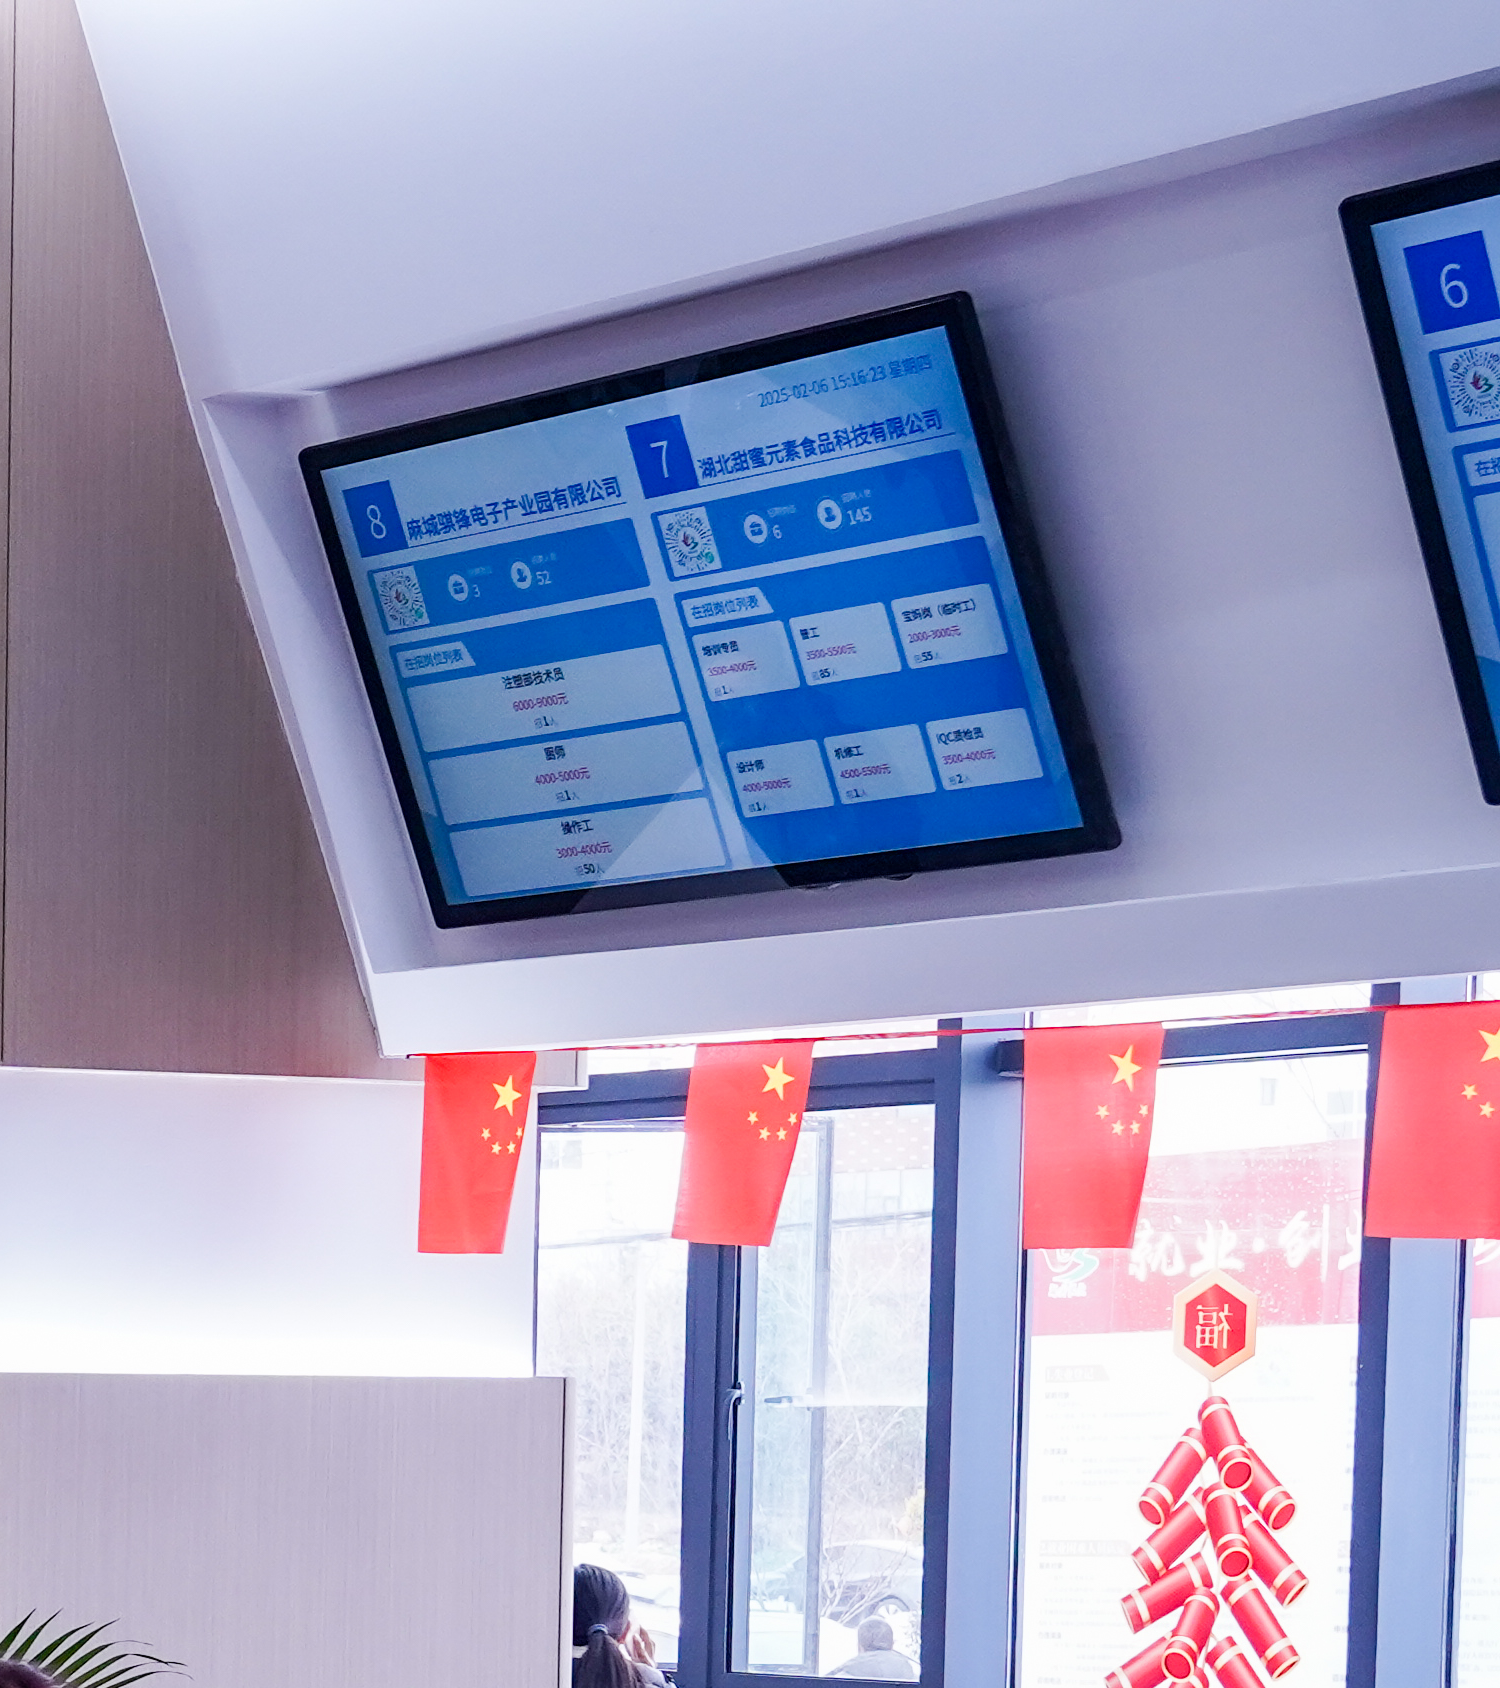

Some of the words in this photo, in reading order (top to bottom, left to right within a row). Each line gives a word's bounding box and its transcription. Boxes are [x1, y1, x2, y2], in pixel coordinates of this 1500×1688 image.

[1438, 262, 1468, 308] 6
[759, 378, 829, 408] 2025-02-06
[831, 365, 888, 391] 15:16:23
[889, 353, 932, 380] 星期四
[698, 408, 942, 480] 湖北甜蜜元素食品科技有限公司
[650, 440, 670, 479] 7
[366, 504, 387, 539] 8
[846, 506, 873, 526] 145
[772, 524, 782, 540] 6
[535, 571, 552, 587] 52
[472, 584, 481, 598] 3
[512, 692, 569, 712] 6000-9000元
[736, 758, 765, 774] 设计师
[535, 767, 591, 786] 4000-5000元
